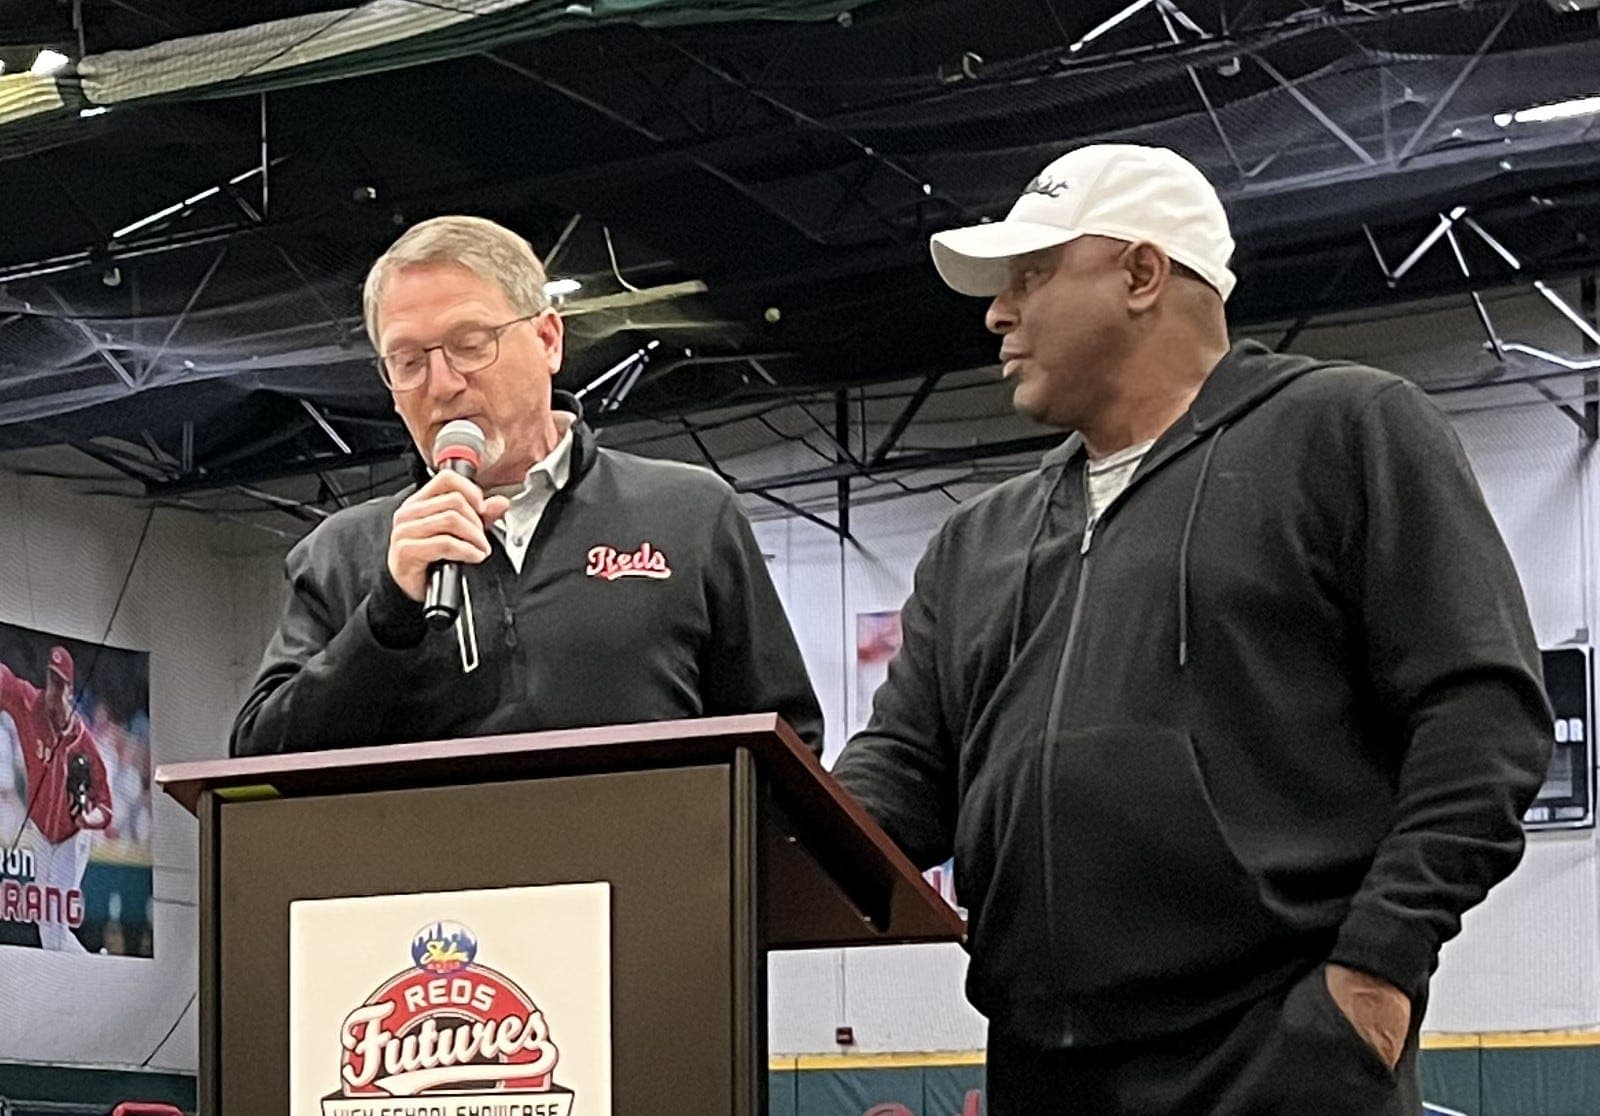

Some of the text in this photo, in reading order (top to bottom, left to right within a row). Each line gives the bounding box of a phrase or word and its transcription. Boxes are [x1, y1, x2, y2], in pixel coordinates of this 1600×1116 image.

[586, 542, 670, 579] Reds
[403, 977, 497, 1013] REDS
[341, 999, 559, 1088] Futures
